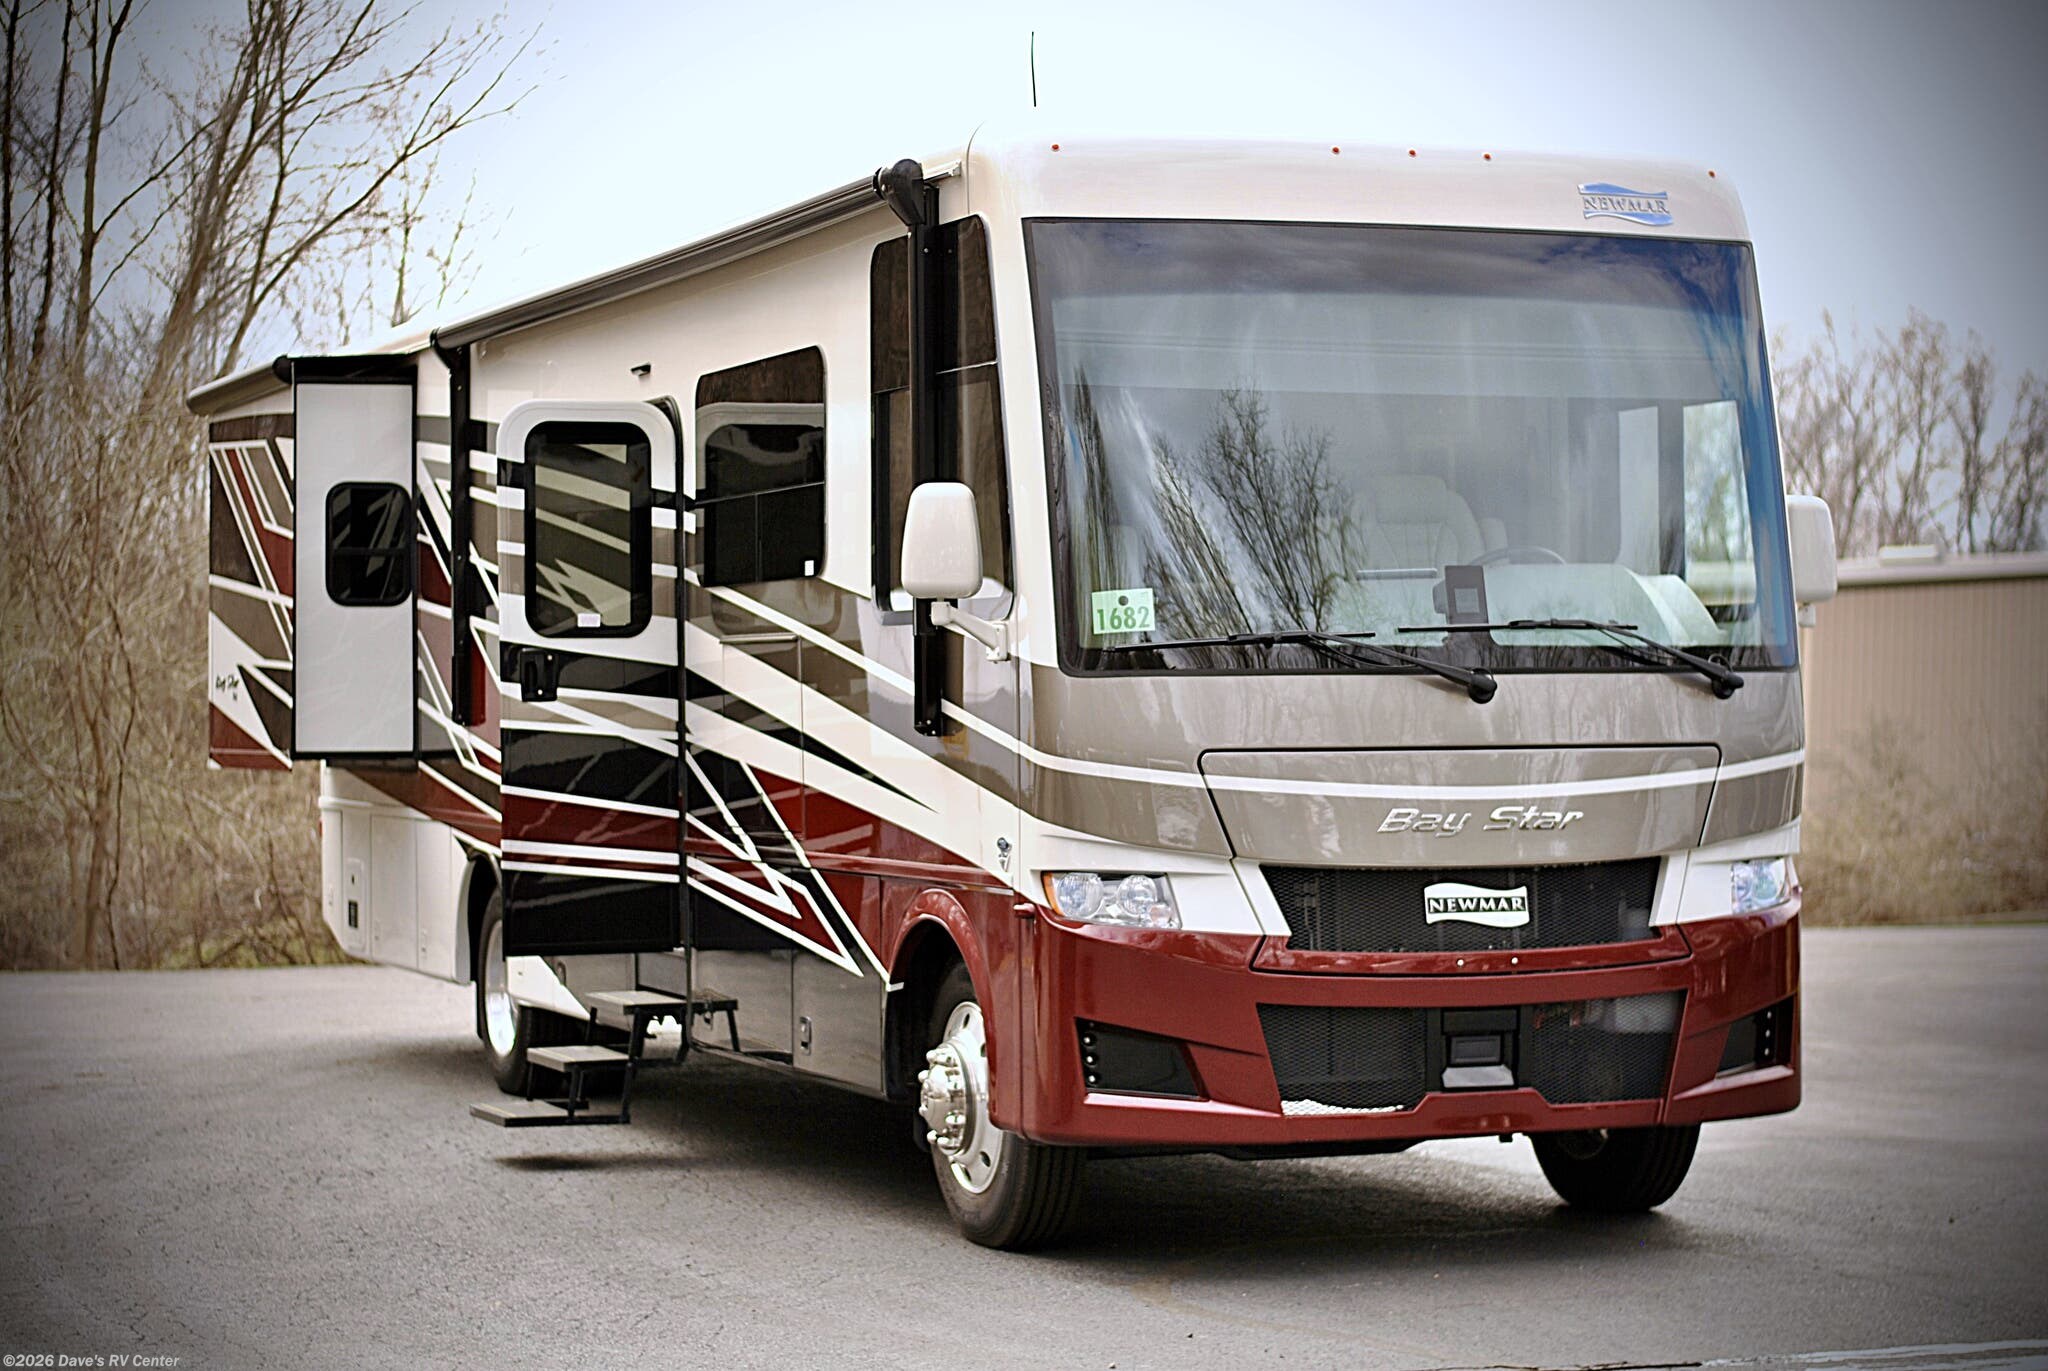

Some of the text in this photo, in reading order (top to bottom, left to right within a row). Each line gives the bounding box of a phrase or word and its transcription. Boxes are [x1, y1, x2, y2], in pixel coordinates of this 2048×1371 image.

[1582, 196, 1670, 213] NEWMAR
[1097, 606, 1151, 631] 1682
[1377, 805, 1584, 838] Bay Star
[1428, 896, 1525, 913] NEWMAR
